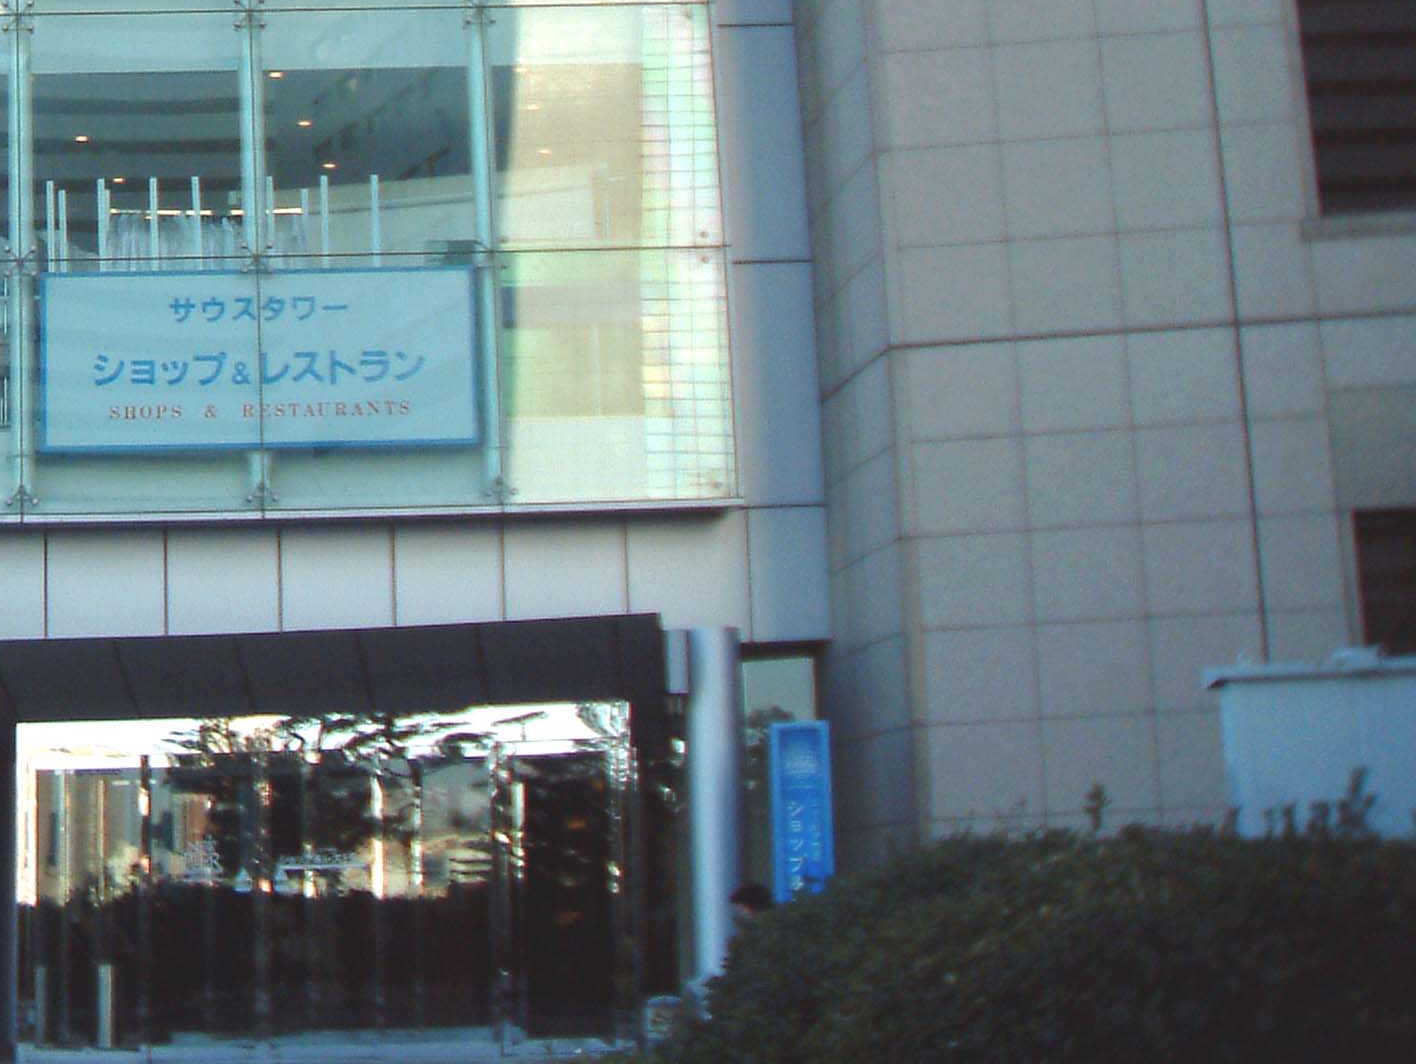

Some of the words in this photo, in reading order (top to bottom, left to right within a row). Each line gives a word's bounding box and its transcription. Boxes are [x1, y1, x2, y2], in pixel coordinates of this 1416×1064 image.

[169, 295, 350, 323] サウスタワー
[109, 402, 184, 421] SHOPS
[203, 403, 218, 420] &
[241, 400, 412, 419] RESTAURANTS
